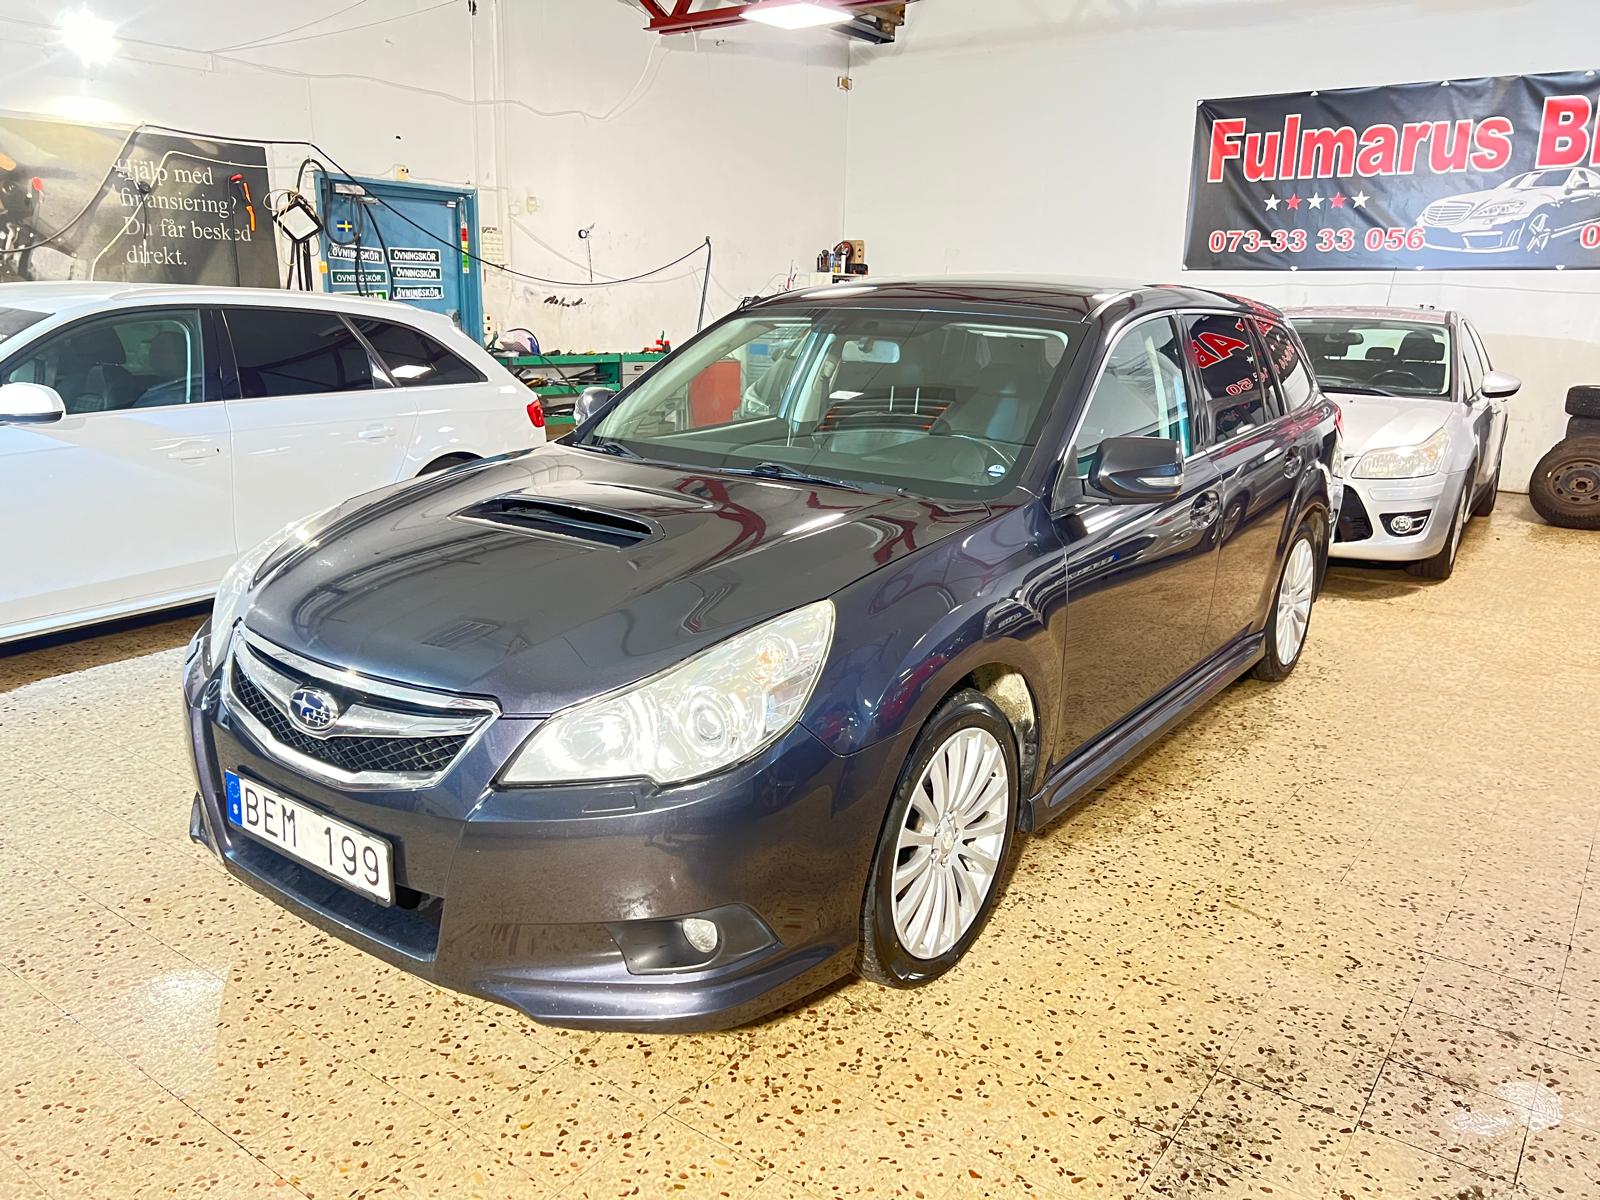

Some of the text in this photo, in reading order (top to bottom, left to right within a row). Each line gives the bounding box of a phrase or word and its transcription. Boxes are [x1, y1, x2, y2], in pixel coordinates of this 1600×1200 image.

[1207, 113, 1514, 183] Fulmarus
[174, 167, 214, 186] med
[123, 216, 252, 242] Du får besked
[1208, 225, 1427, 253] 073-33 33 056
[126, 245, 188, 266] direkt.
[332, 246, 380, 261] ÖVNINSKÖR
[394, 250, 436, 261] ÖVNINGSKÖR
[396, 267, 437, 278] ÖVNINGSKÖR
[396, 287, 439, 298] ÖVNINGSKÖR
[245, 787, 380, 887] BEM 199
